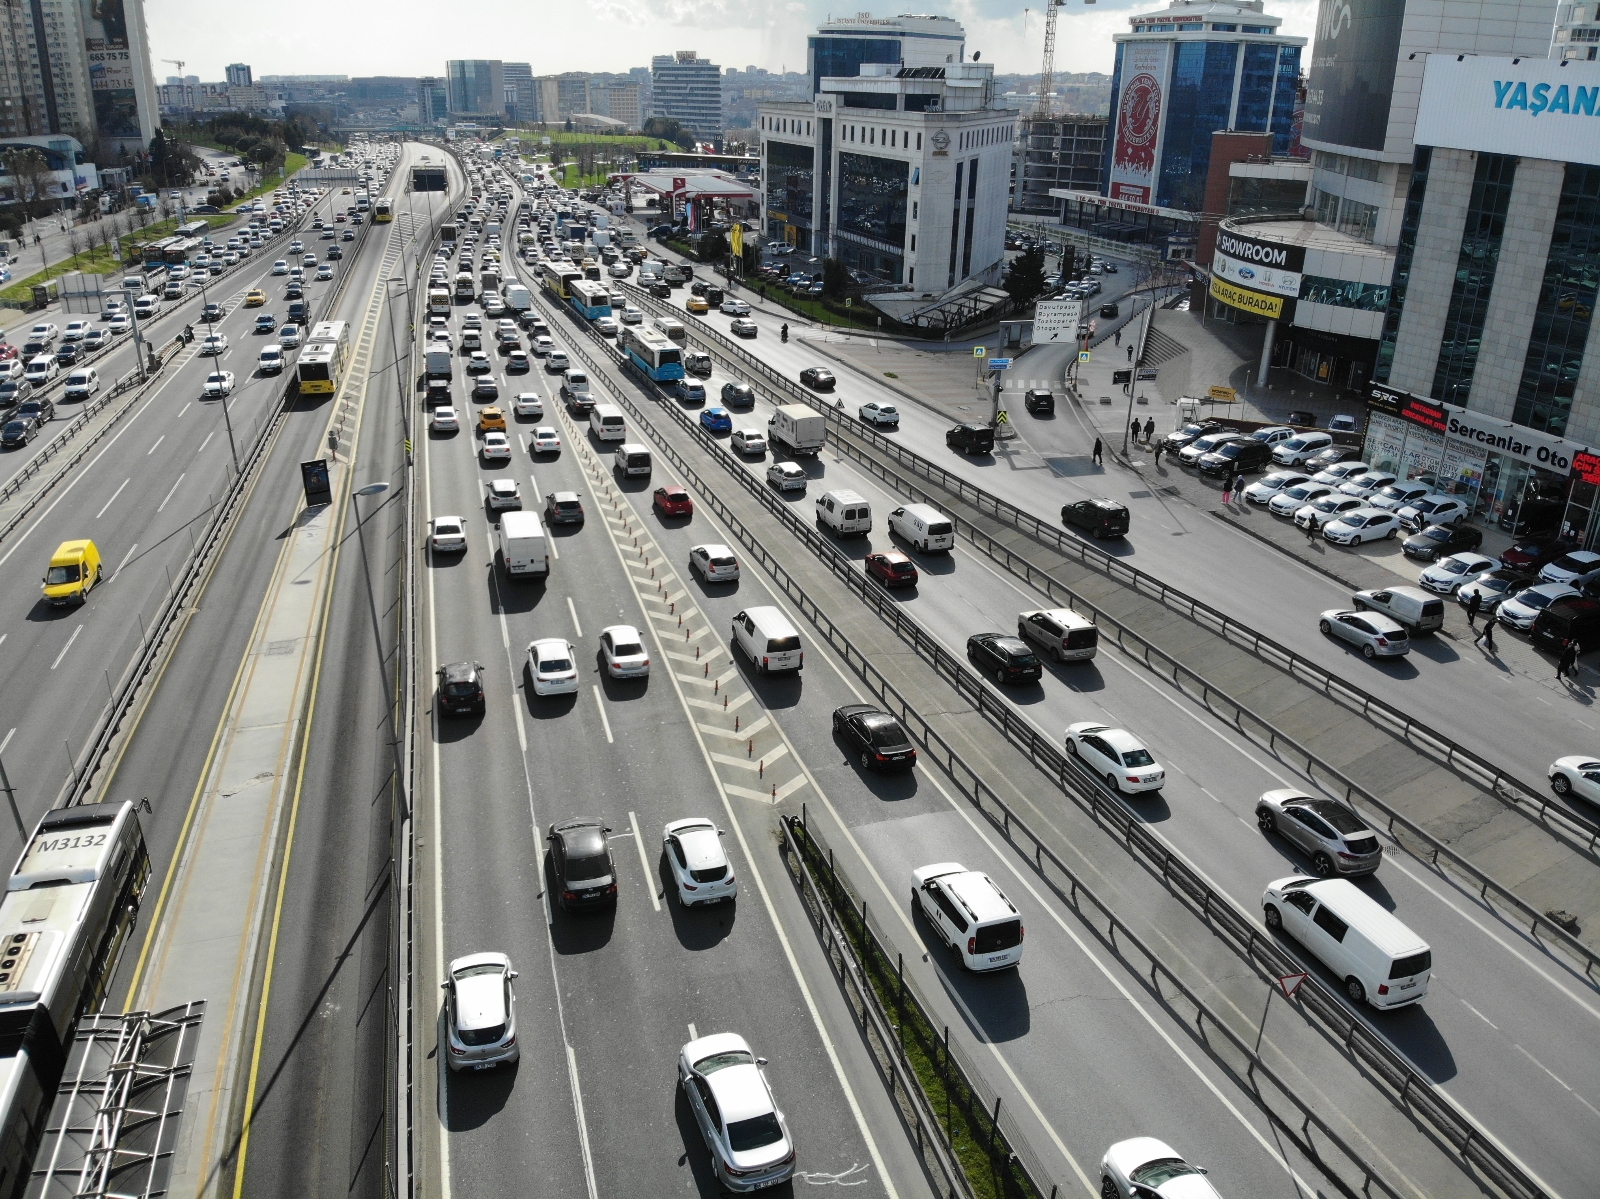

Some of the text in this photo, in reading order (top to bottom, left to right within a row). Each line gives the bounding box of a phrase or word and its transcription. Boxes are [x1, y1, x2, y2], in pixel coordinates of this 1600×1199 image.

[111, 80, 120, 88] 73
[123, 79, 132, 87] 15
[1222, 236, 1286, 265] SHOWROOM
[1221, 287, 1236, 304] ARAÇ
[1238, 294, 1277, 313] BURADA!
[1371, 390, 1398, 403] SRC
[1449, 418, 1532, 456] Sercanlar
[1536, 446, 1568, 469] Oto
[37, 834, 106, 853] M3132
